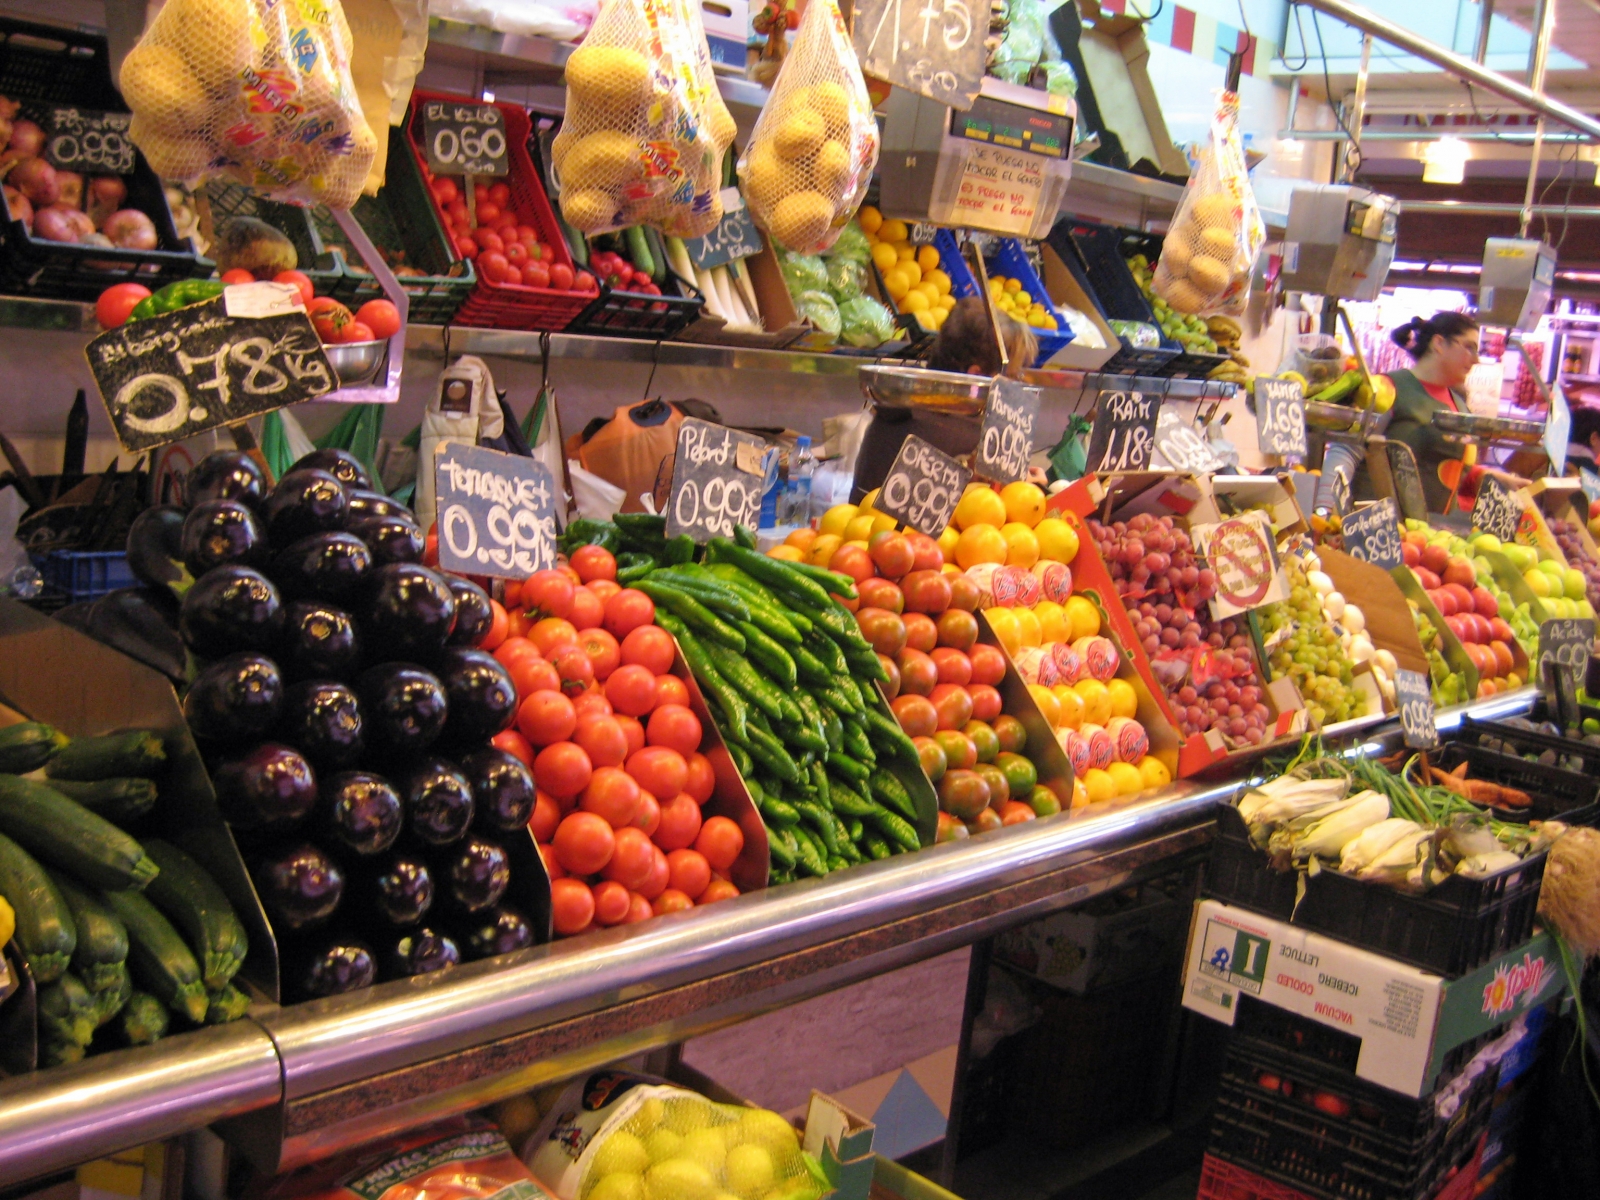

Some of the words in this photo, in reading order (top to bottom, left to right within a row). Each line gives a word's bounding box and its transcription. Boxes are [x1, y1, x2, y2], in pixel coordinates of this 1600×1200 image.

[242, 66, 298, 121] MIRO
[433, 125, 506, 164] 0.60
[637, 138, 679, 183] MIRO
[1002, 170, 1013, 180] EL
[1010, 193, 1025, 205] NO
[1261, 399, 1304, 441] 1.69
[1279, 944, 1320, 968] LETTUCE
[1276, 973, 1315, 996] COOLED
[1317, 972, 1359, 997] ICEBERG
[1313, 1001, 1354, 1026] VACUUM
